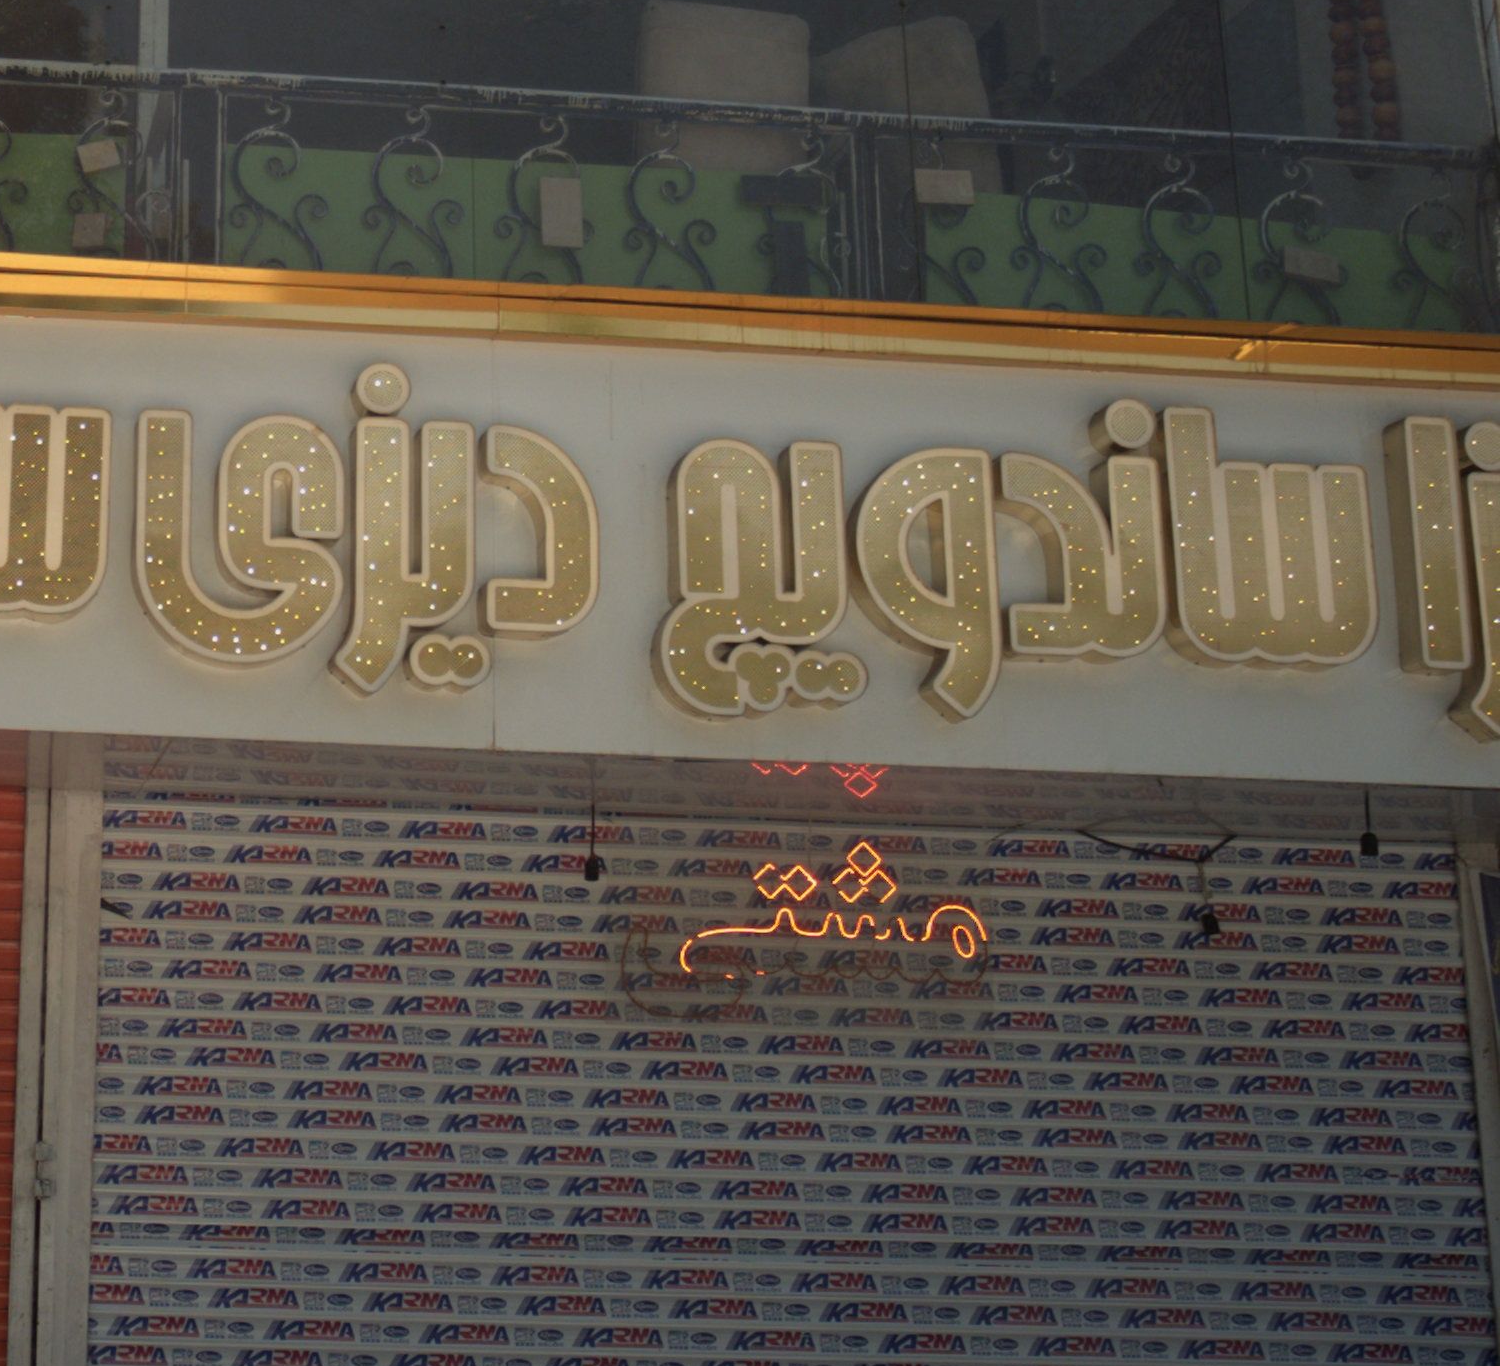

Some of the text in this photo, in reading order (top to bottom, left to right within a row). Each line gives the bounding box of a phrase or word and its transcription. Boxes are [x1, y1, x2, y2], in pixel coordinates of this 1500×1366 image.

[134, 362, 600, 697] دیزی
[653, 398, 1380, 722] ساندویچ
[102, 808, 782, 851] KARMA KARMA KARMA KARMA
[221, 844, 312, 866] KARMA
[371, 848, 462, 870] KARMA
[1267, 846, 1358, 868] KARMA
[149, 872, 240, 894] KARMA
[299, 876, 390, 898] KARMA
[449, 880, 540, 902] KARMA
[595, 885, 686, 907] KARMA
[1096, 870, 1326, 897] KARMA KARMA
[141, 899, 232, 921] KARMA
[292, 904, 382, 926] KARMA
[440, 909, 530, 931] KARMA
[590, 913, 680, 935] KARMA
[1032, 897, 1406, 928] KARMA KARMA
[222, 931, 312, 953] KARMA
[372, 936, 462, 958] KARMA
[521, 940, 612, 962] KARMA
[1027, 925, 1404, 955] KARMA KARMA
[161, 958, 252, 980] KARMA
[313, 962, 404, 984] KARMA
[463, 967, 554, 989] KARMA
[1051, 982, 1142, 1004] KARMA
[1195, 986, 1286, 1008] KARMA
[1338, 990, 1428, 1012] KARMA
[1246, 960, 1336, 982] KARMA
[232, 991, 1348, 1039] KARMA KARMA KARMA KARMA KARMA
[157, 1017, 248, 1039] KARMA
[308, 1022, 398, 1044] KARMA
[459, 1026, 550, 1048] KARMA
[608, 1030, 698, 1052] KARMA
[902, 1038, 992, 1060] KARMA
[1336, 1049, 1426, 1071] KARMA
[186, 1046, 276, 1068] KARMA
[338, 1051, 428, 1073] KARMA
[489, 1056, 580, 1078] KARMA
[639, 1060, 730, 1082] KARMA
[787, 1064, 878, 1086] KARMA
[934, 1067, 1024, 1089] KARMA
[1226, 1074, 1316, 1096] KARMA
[1371, 1078, 1462, 1100] KARMA
[132, 1075, 964, 1116] KARMA KARMA KARMA KARMA KARMA
[135, 1104, 226, 1126] KARMA
[287, 1108, 378, 1130] KARMA
[438, 1112, 528, 1134] KARMA
[587, 1116, 678, 1138] KARMA
[736, 1120, 826, 1142] KARMA
[1030, 1126, 1120, 1148] KARMA
[1175, 1129, 1266, 1151] KARMA
[1319, 1134, 1410, 1156] KARMA
[366, 1140, 456, 1162] KARMA
[516, 1145, 606, 1167] KARMA
[665, 1148, 756, 1170] KARMA
[813, 1151, 904, 1173] KARMA
[959, 1155, 1050, 1177] KARMA
[1251, 1161, 1342, 1183] KARMA
[97, 1163, 188, 1185] KARMA
[252, 1167, 342, 1189] KARMA
[406, 1171, 496, 1193] KARMA
[558, 1175, 648, 1197] KARMA
[709, 1179, 800, 1201] KARMA
[859, 1182, 950, 1204] KARMA
[1008, 1186, 1098, 1208] KARMA
[1155, 1189, 1246, 1211] KARMA
[108, 1194, 198, 1216] KARMA
[562, 1206, 652, 1228] KARMA
[711, 1209, 802, 1231] KARMA
[859, 1212, 950, 1234] KARMA
[1006, 1215, 1096, 1237] KARMA
[1152, 1218, 1242, 1240] KARMA
[1297, 1221, 1388, 1243] KARMA
[333, 1225, 424, 1247] KARMA
[641, 1233, 732, 1255] KARMA
[943, 1240, 1034, 1262] KARMA
[186, 1257, 1464, 1306] KARMA KARMA KARMA KARMA KARMA KARMA KARMA KARMA
[209, 1286, 1206, 1329] KARMA KARMA KARMA KARMA KARMA
[264, 1319, 354, 1341] KARMA
[419, 1323, 510, 1345] KARMA
[573, 1326, 664, 1348] KARMA
[725, 1330, 816, 1352] KARMA
[877, 1332, 968, 1354] KARMA
[1026, 1335, 1116, 1357] KARMA
[1175, 1338, 1266, 1360] KARMA
